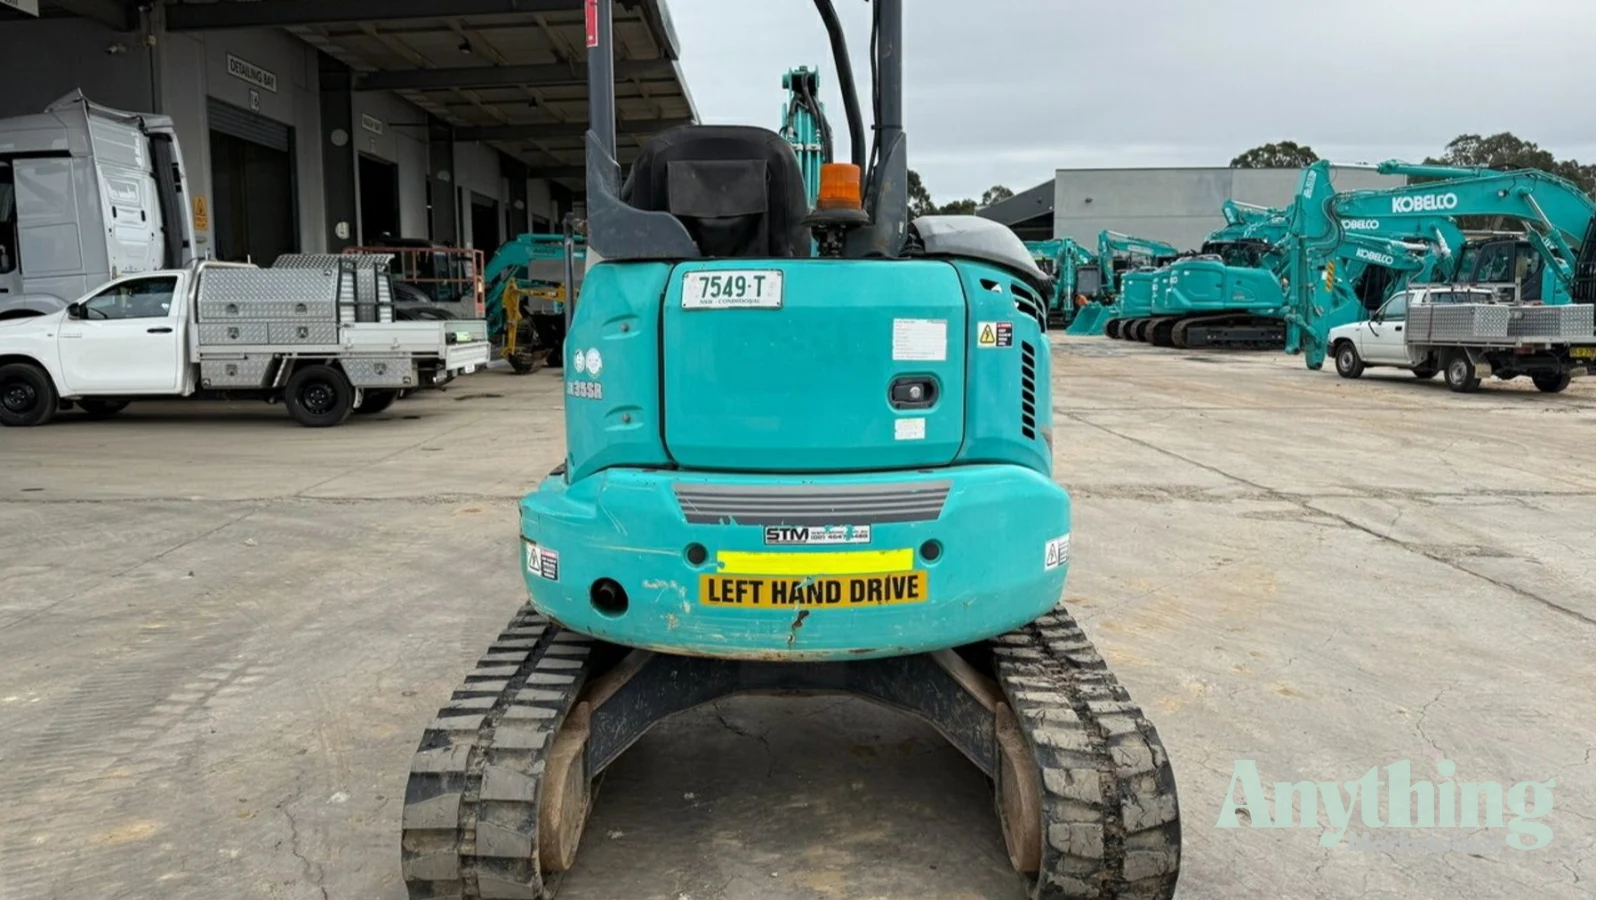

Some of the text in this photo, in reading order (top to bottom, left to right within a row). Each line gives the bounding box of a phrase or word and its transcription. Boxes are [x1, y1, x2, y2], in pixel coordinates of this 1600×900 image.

[230, 59, 275, 89] DETAILING BAY
[1391, 192, 1458, 213] KOBELCO
[1355, 247, 1394, 265] KOBELCO
[766, 528, 809, 541] STM
[708, 575, 919, 604] LEFT HAND DRIVE
